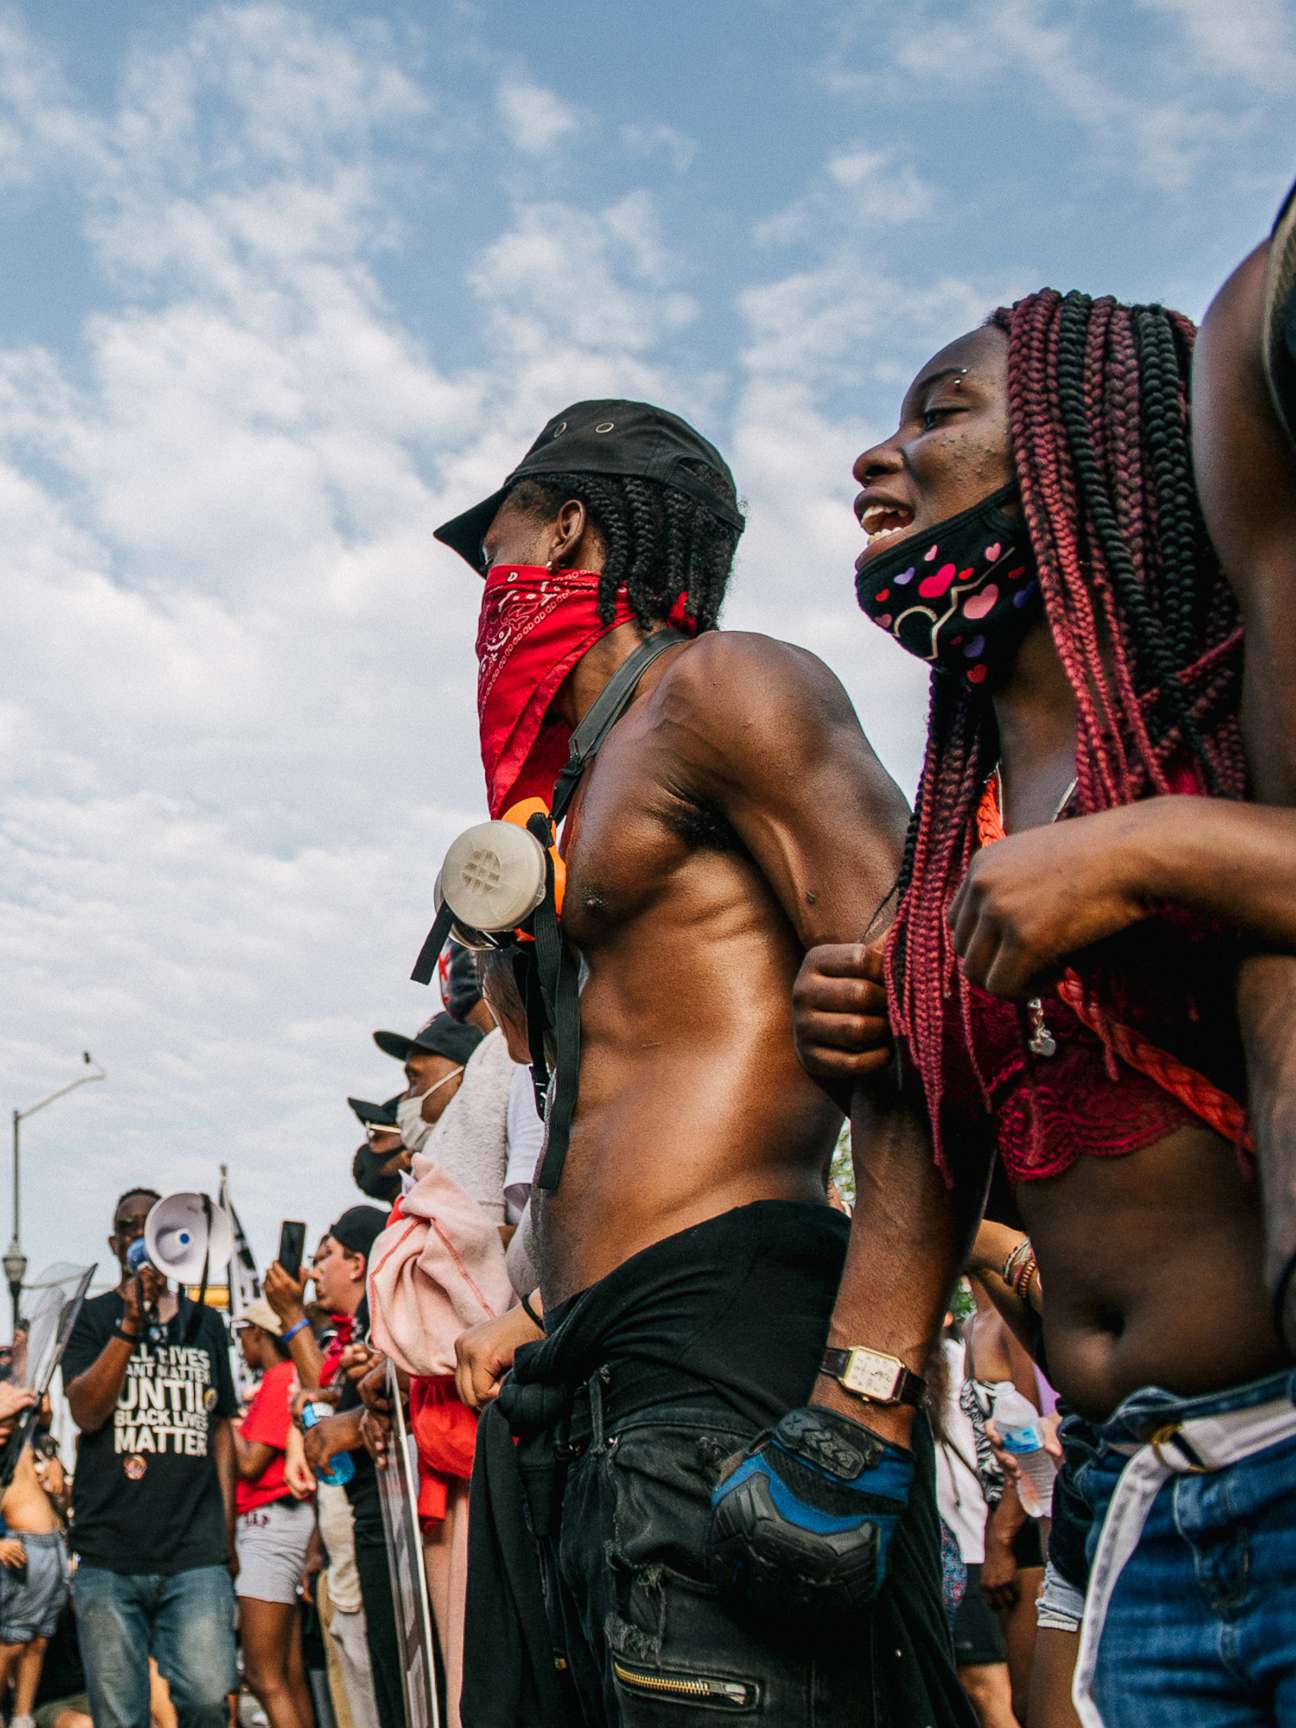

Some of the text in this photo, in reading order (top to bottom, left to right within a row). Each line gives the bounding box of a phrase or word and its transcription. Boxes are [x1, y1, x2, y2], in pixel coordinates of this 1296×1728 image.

[155, 1345, 210, 1370] LIVES
[157, 1364, 210, 1384] MATTER
[118, 1377, 207, 1415] UNTIL
[114, 1409, 208, 1431] BLACK LIVES
[114, 1425, 208, 1456] MATTER
